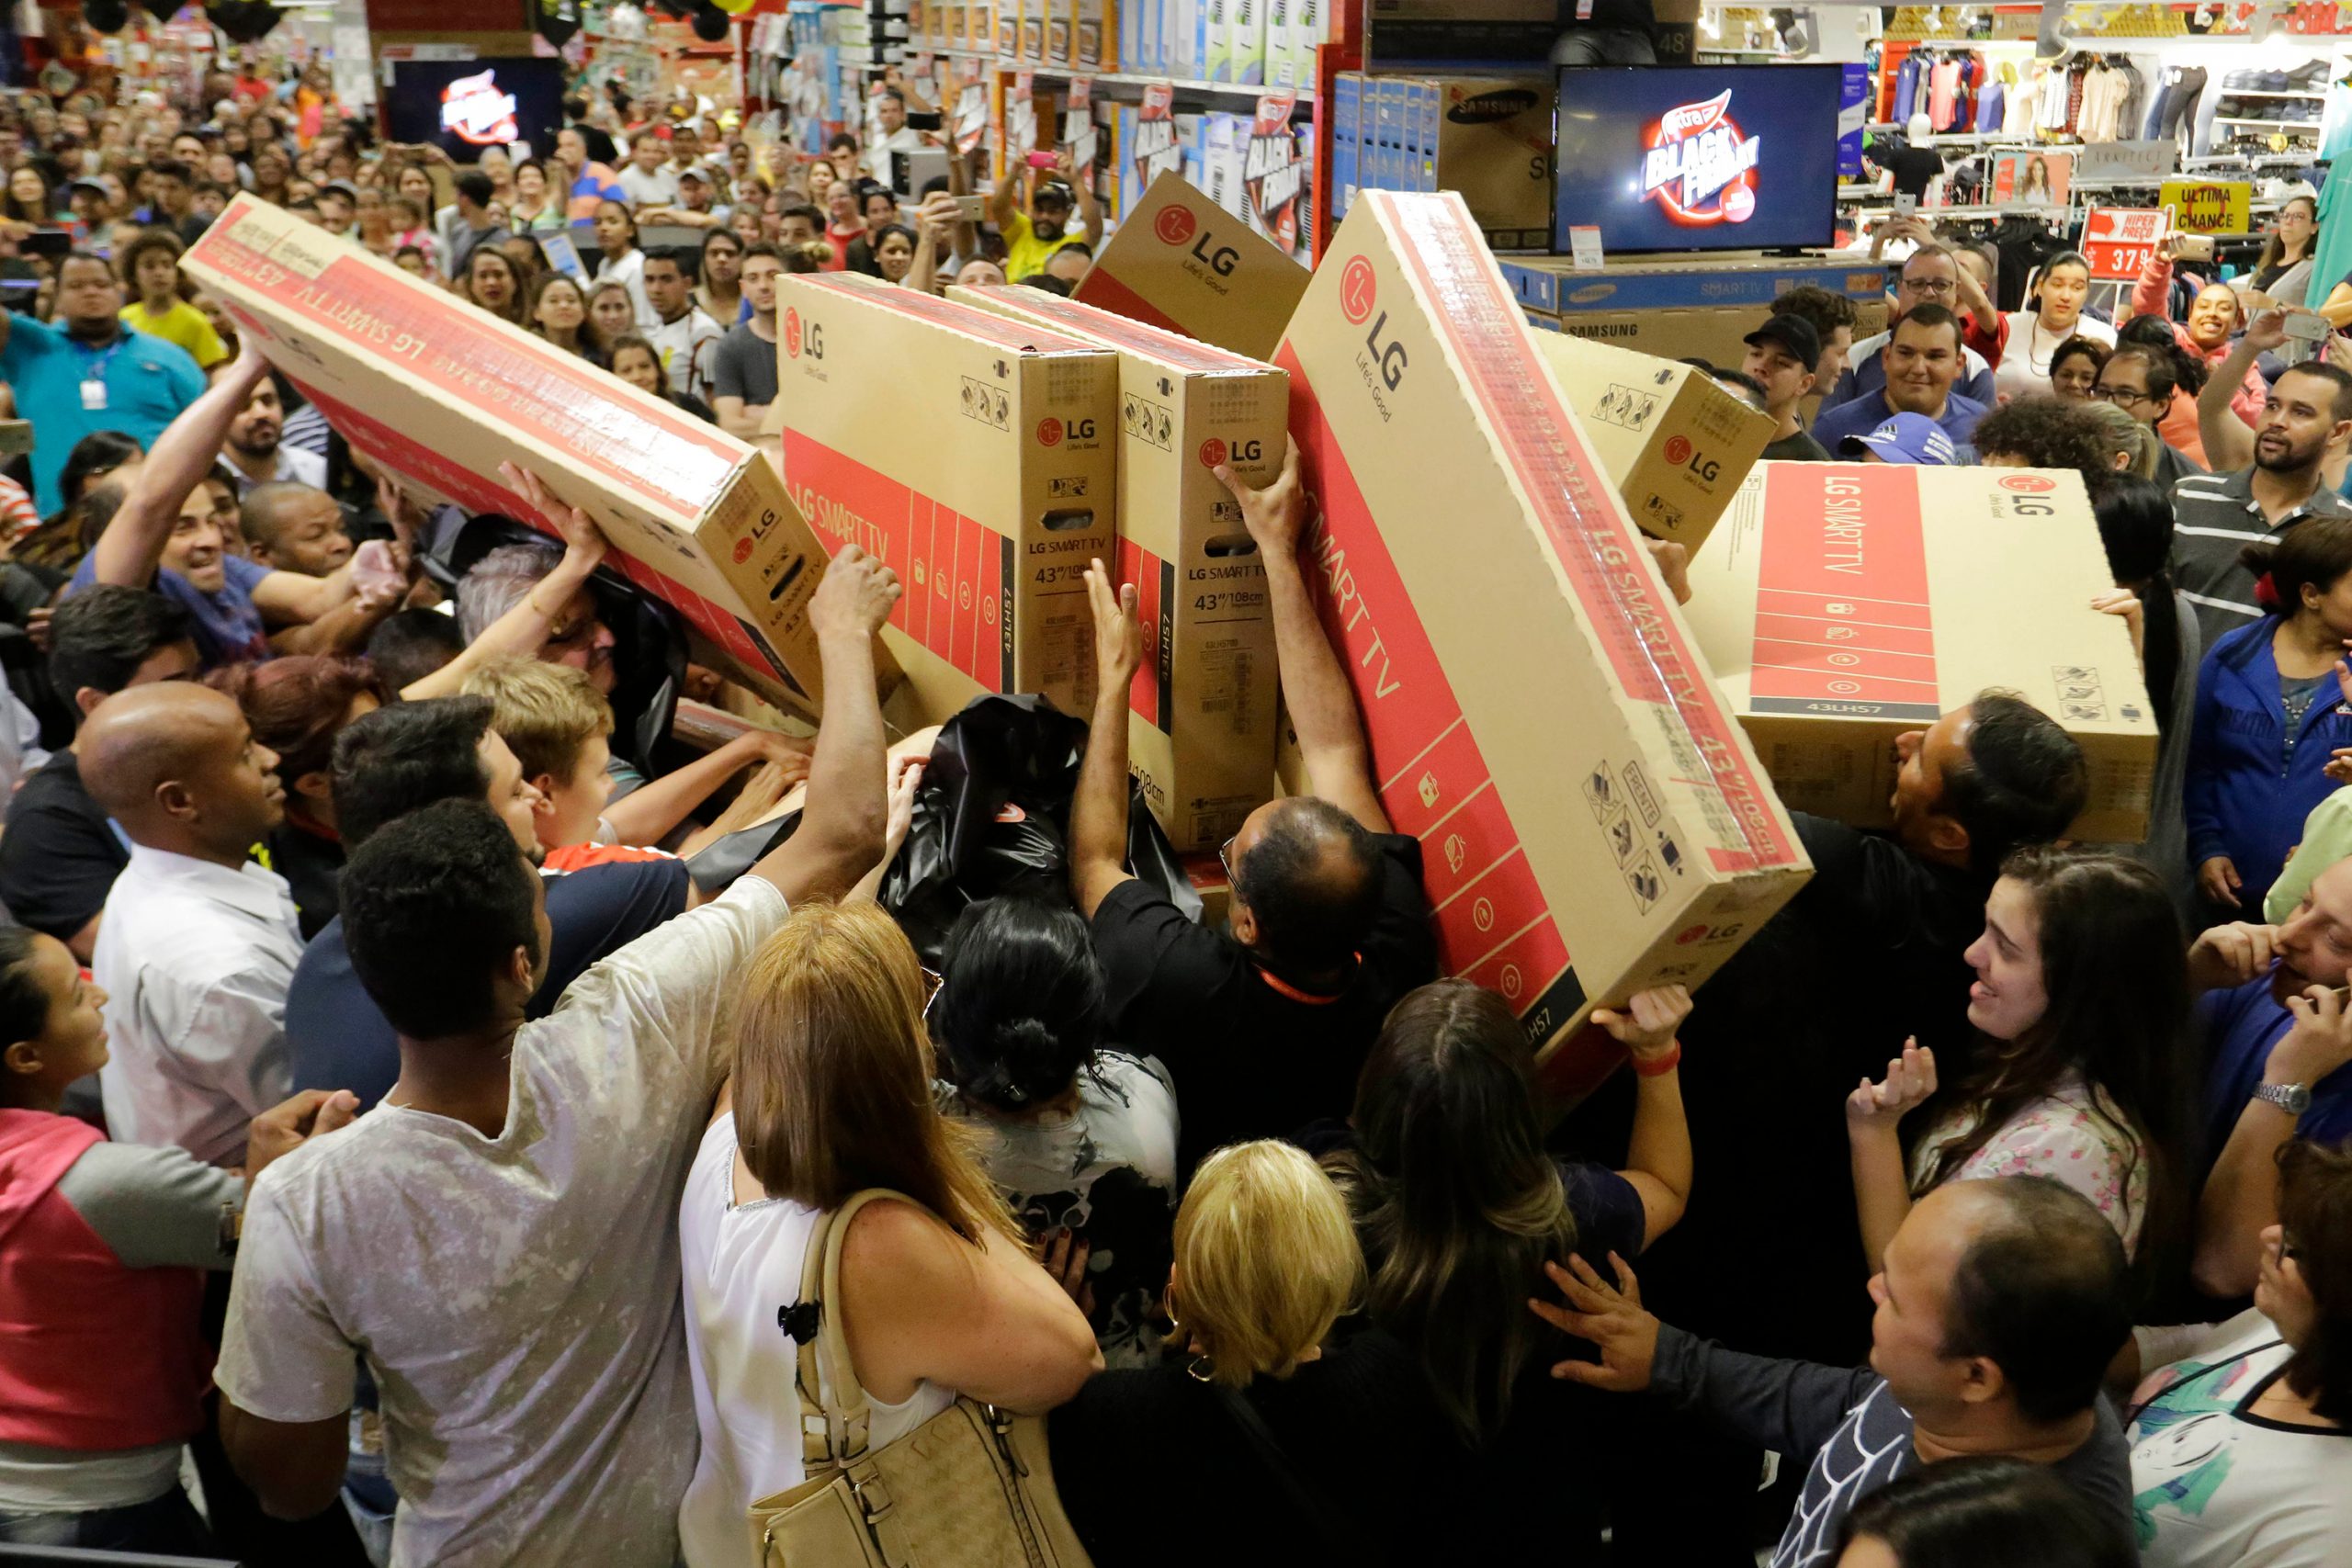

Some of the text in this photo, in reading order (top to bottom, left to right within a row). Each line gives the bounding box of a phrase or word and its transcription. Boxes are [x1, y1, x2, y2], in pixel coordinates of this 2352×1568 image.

[1457, 97, 1529, 115] SAMSUNG
[1645, 127, 1735, 191] BLACK
[2125, 213, 2157, 227] HIPER
[2178, 211, 2234, 229] CHANCE
[2120, 226, 2154, 243] PREÇO
[1191, 231, 1241, 277] LG
[1204, 275, 1230, 296] Good
[803, 319, 823, 360] LG
[1568, 323, 1638, 338] SAMSUNG
[390, 333, 427, 360] LG
[1366, 310, 1408, 392] LG
[1354, 351, 1393, 423] Life's Good
[1067, 419, 1095, 440] LG
[1231, 440, 1262, 462] LG
[1689, 452, 1721, 482] LG
[2011, 494, 2054, 517] LG
[751, 508, 776, 540] LG
[795, 483, 815, 523] LG
[817, 495, 865, 547] SMART
[866, 522, 888, 564] TV
[1824, 475, 1863, 575] LG SMART TV
[1029, 537, 1107, 555] LG SMART TV
[1189, 568, 1206, 581] LG
[1209, 566, 1250, 580] SMART
[1003, 588, 1014, 654] 43LH57
[1593, 530, 1629, 567] LG
[1615, 572, 1680, 664] SMART
[1665, 666, 1705, 708] TV
[1362, 626, 1401, 699] TV
[1806, 702, 1883, 715] 43LH57
[1624, 766, 1657, 824] FRENTE
[1704, 921, 1745, 941] LG
[1524, 1007, 1553, 1043] LH57
